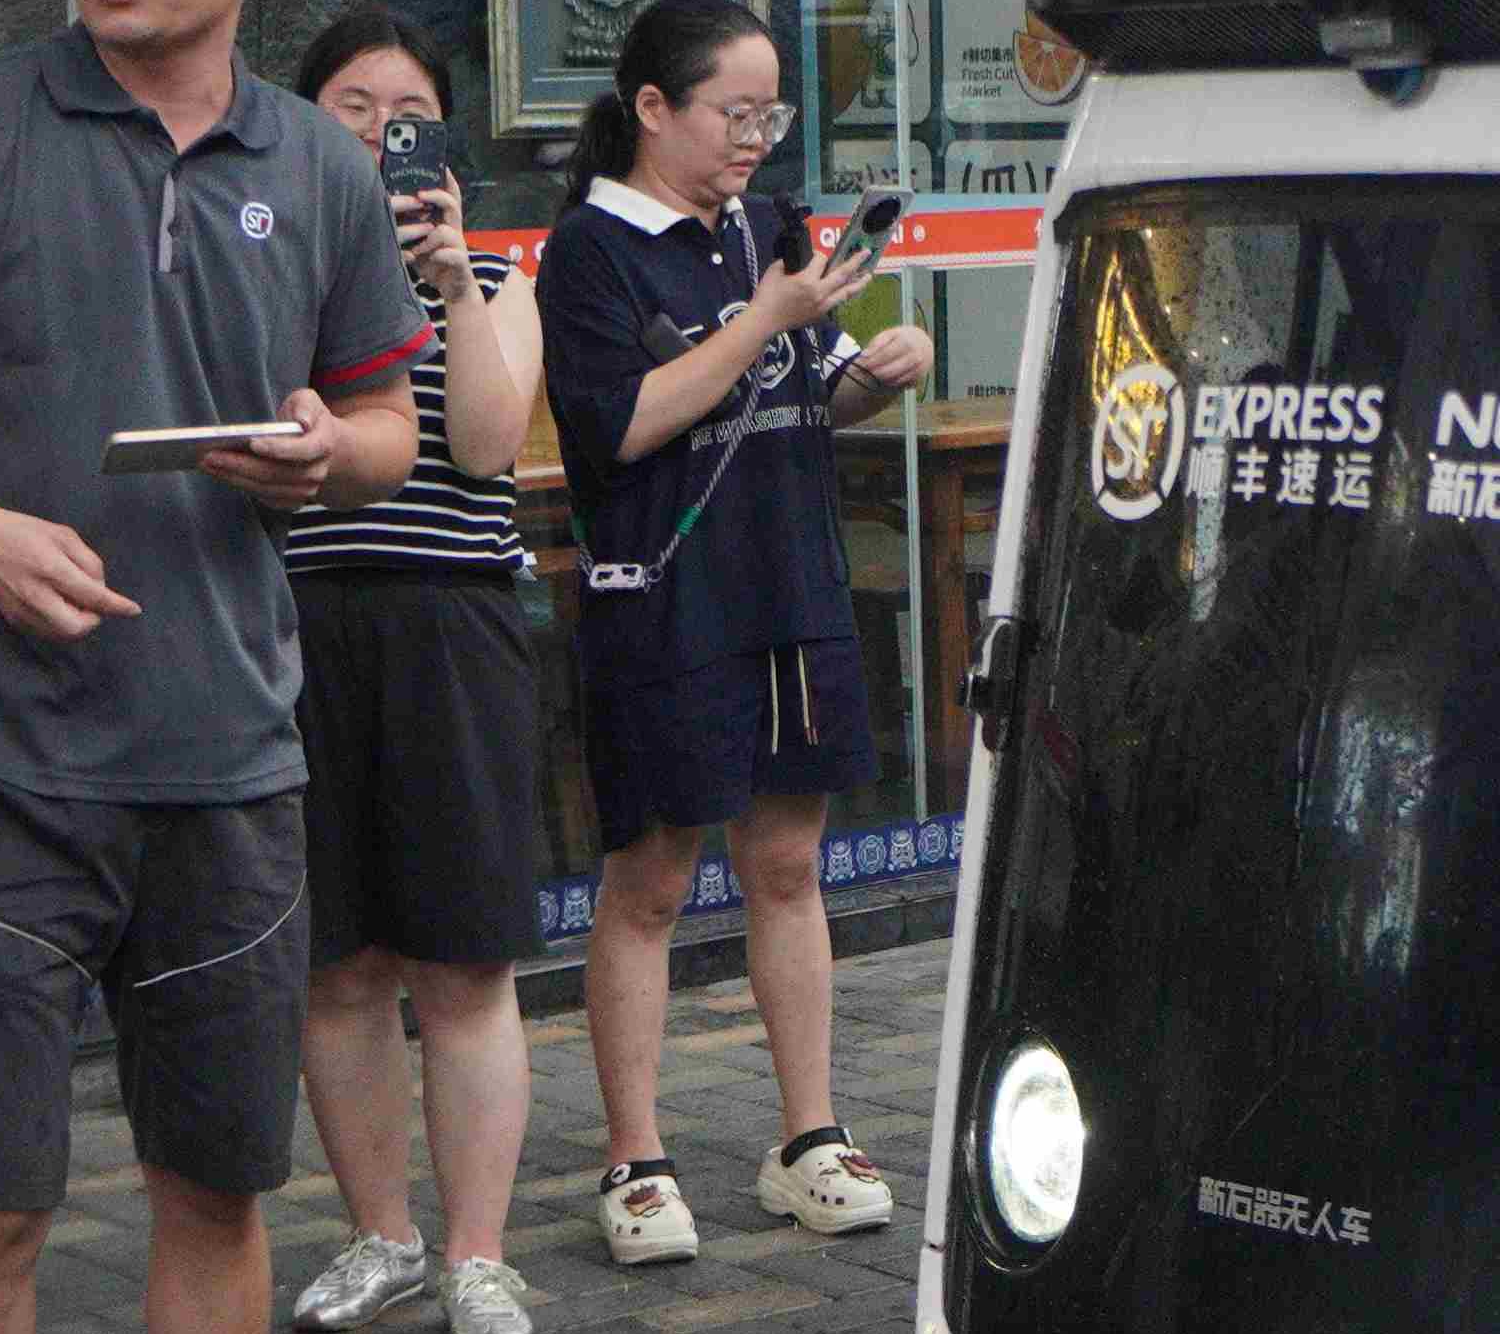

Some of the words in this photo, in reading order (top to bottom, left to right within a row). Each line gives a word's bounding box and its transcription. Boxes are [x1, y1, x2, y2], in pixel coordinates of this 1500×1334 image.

[1192, 383, 1385, 445] EXPRESS
[1184, 448, 1373, 511] 顺丰速运
[1197, 1175, 1372, 1246] 新石器无人车
